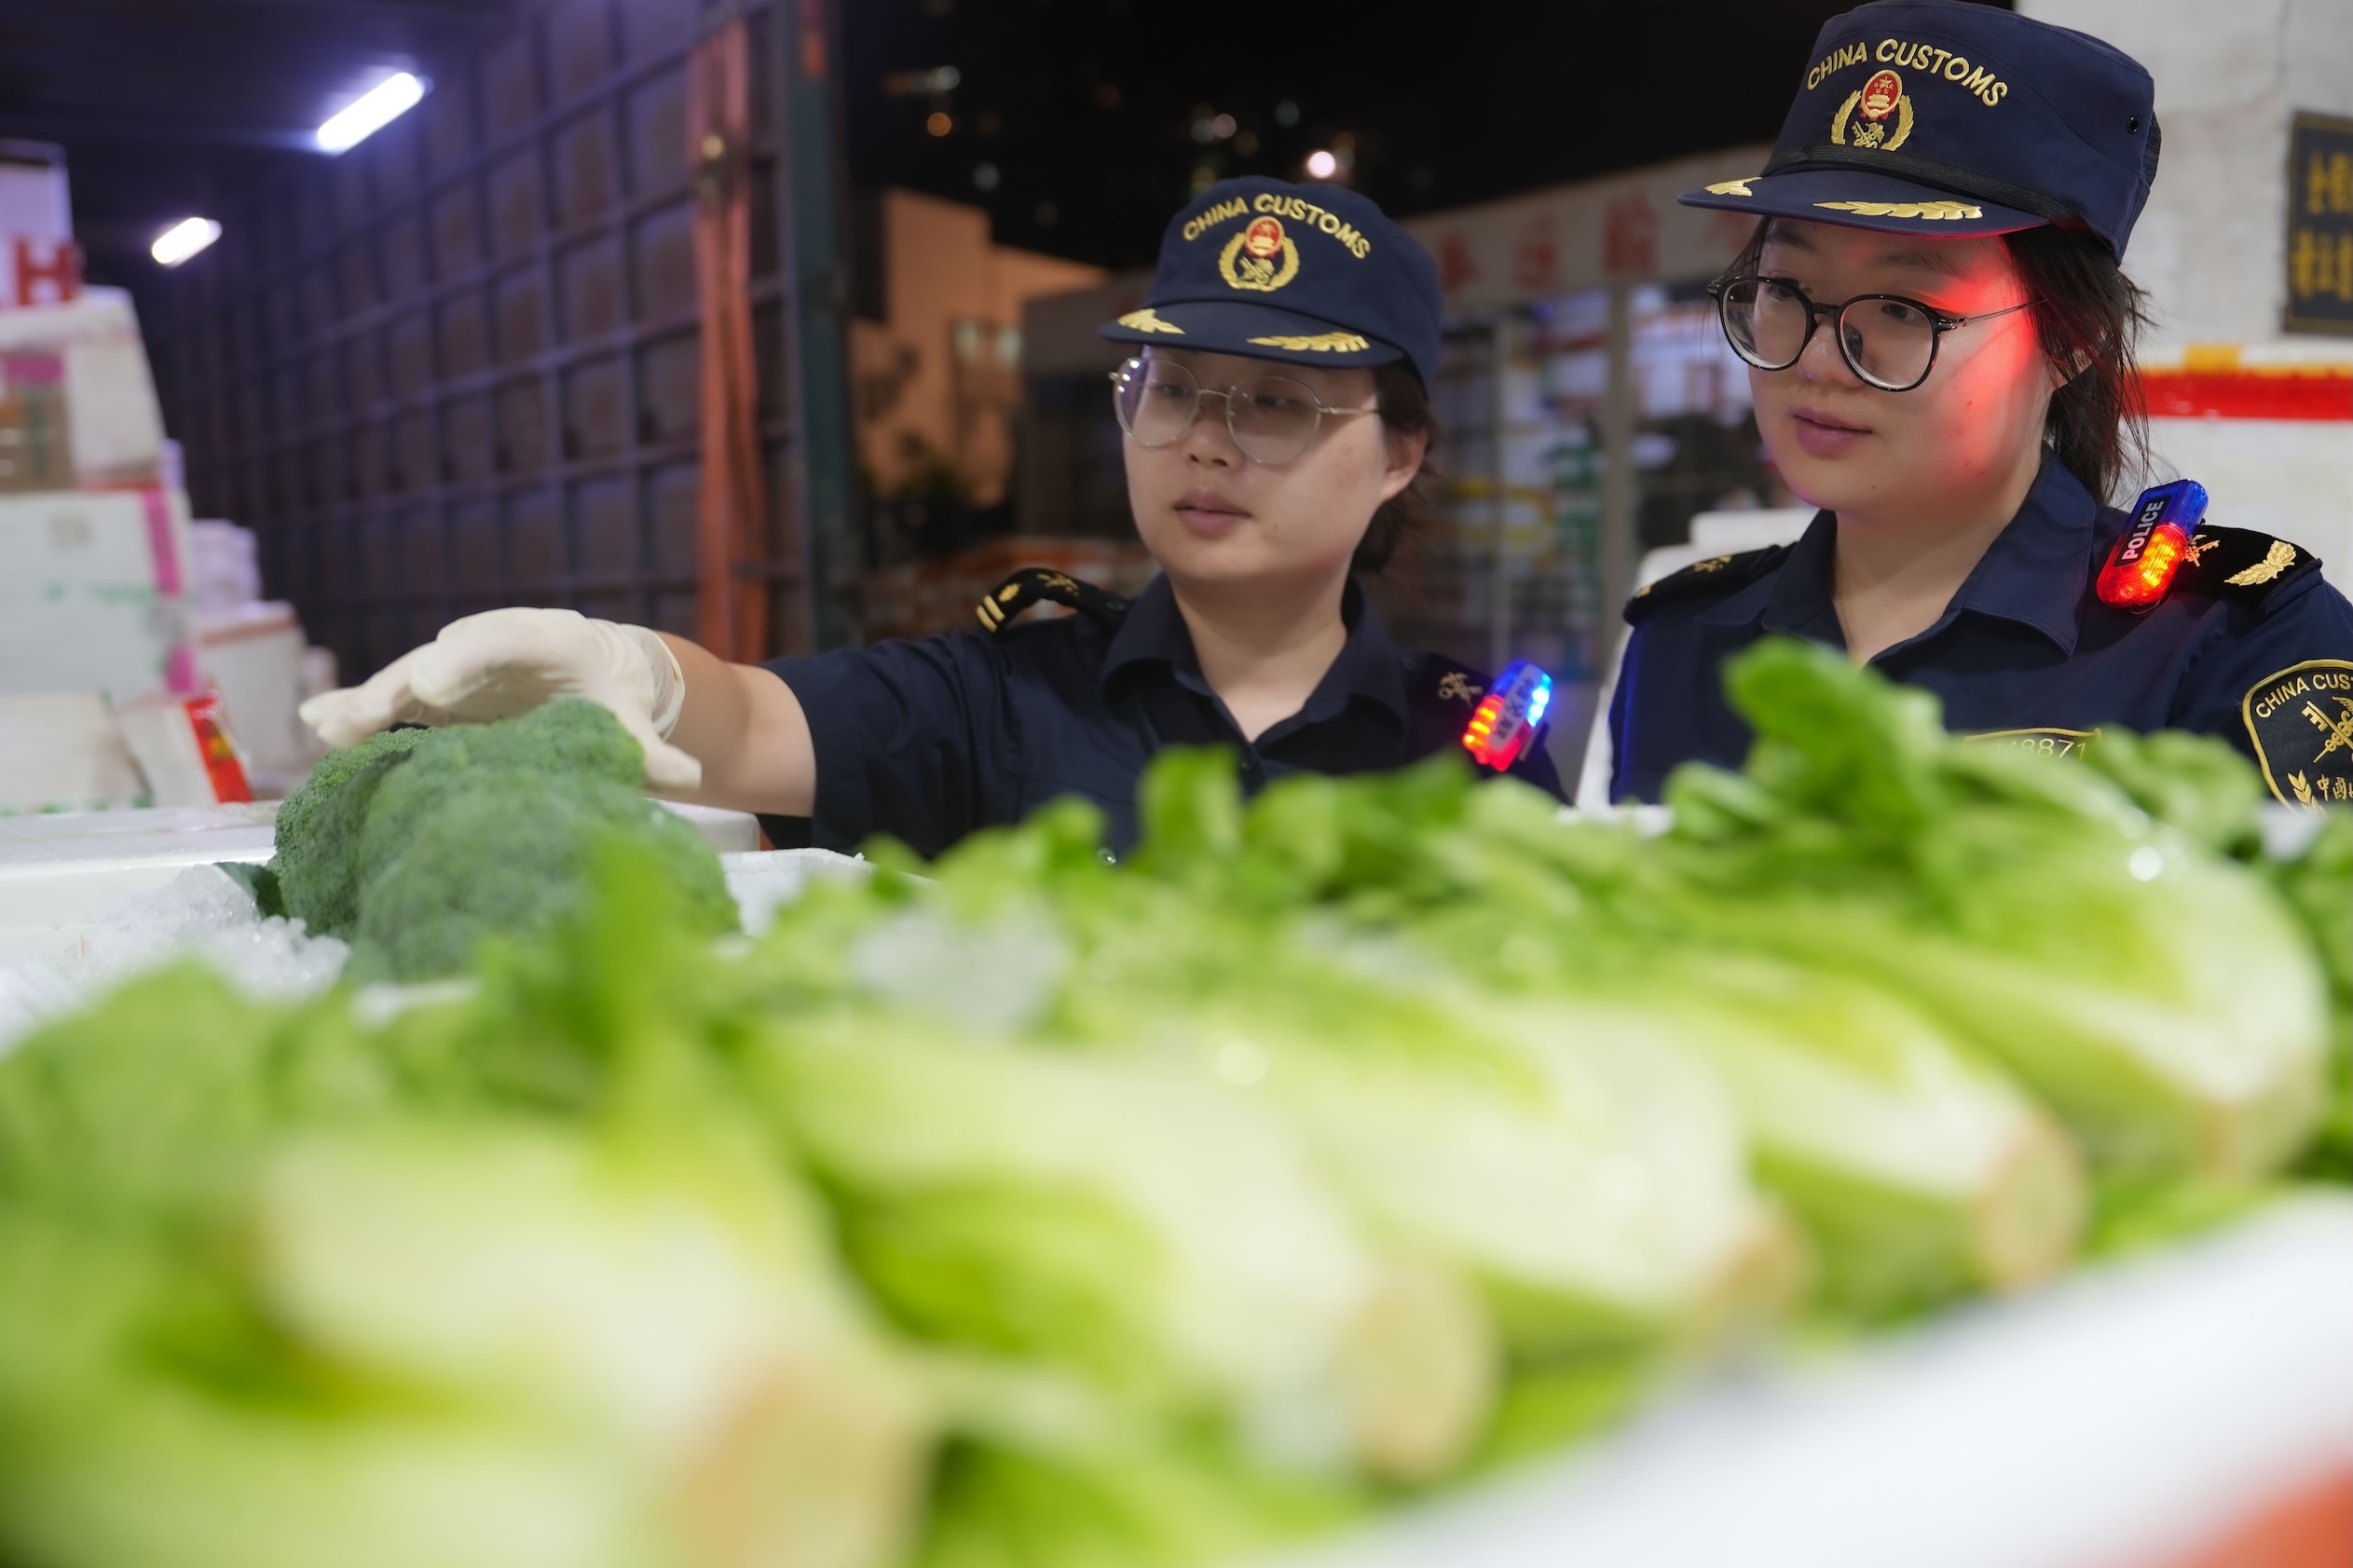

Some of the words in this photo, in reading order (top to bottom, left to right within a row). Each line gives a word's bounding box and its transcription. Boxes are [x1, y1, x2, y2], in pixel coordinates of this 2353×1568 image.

[1807, 41, 1867, 90] CHINA
[1875, 38, 2008, 107] CUSTOMS
[1183, 196, 1250, 241] CHINA
[1253, 193, 1372, 260] CUSTOMS
[2121, 500, 2165, 561] POLICE
[2255, 675, 2311, 718] CHINA
[2312, 673, 2353, 690] CUS
